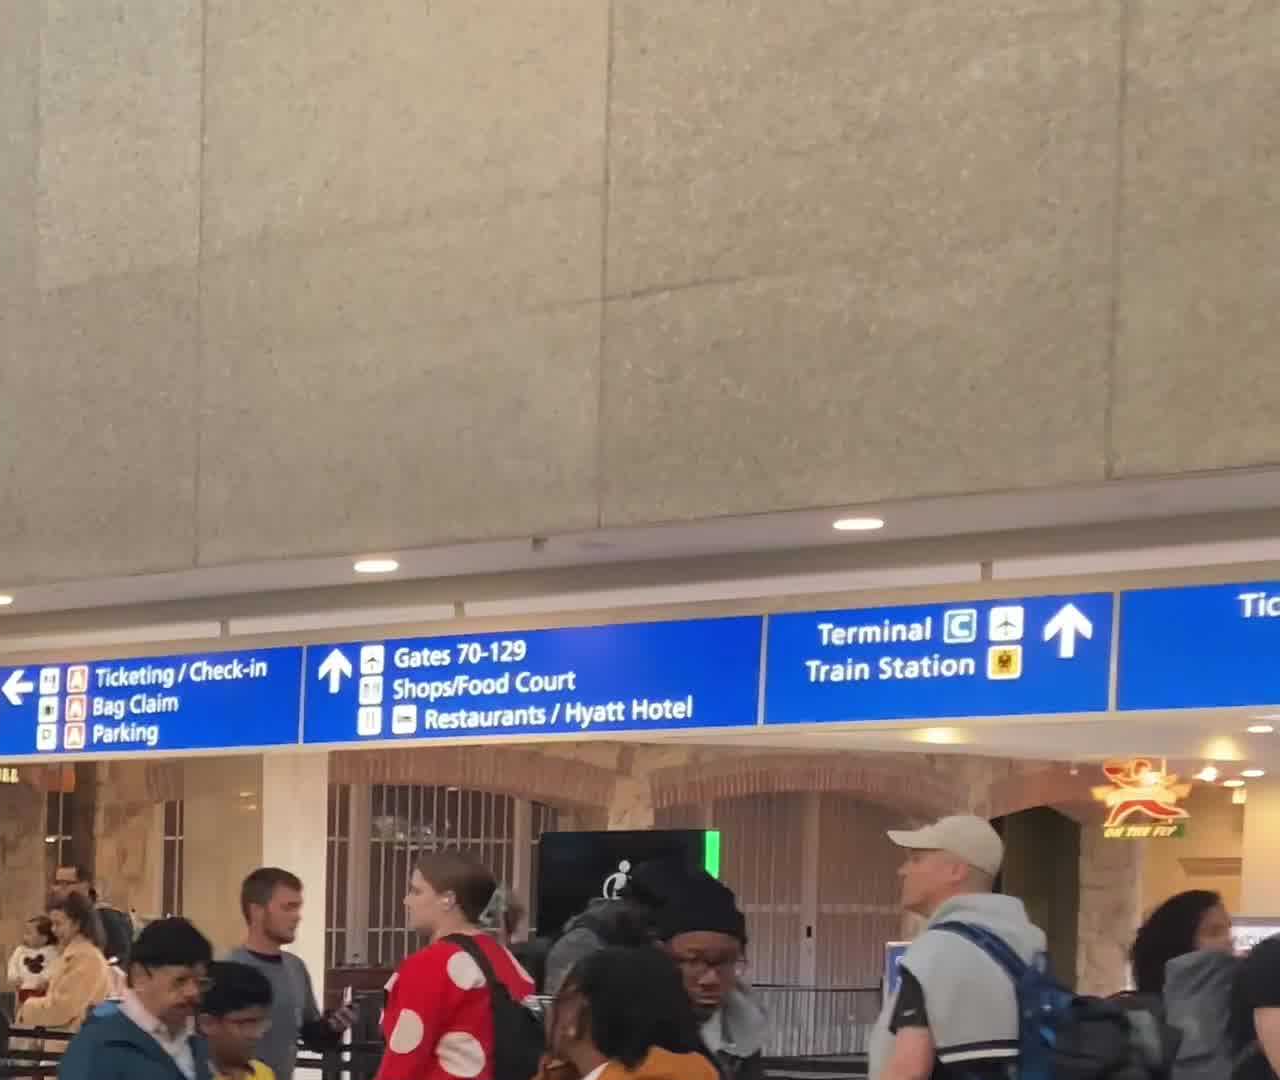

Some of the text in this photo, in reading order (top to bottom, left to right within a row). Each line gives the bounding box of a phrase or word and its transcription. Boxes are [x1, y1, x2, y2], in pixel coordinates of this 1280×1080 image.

[818, 617, 932, 647] Terminal
[394, 640, 526, 669] Gates 70-129
[805, 653, 976, 683] Train Station
[95, 666, 174, 690] Ticketing
[177, 664, 186, 684] /
[189, 659, 268, 683] Check-in
[393, 671, 577, 701] Shops/Food Court
[93, 697, 126, 719] Bag
[130, 694, 179, 715] Claim
[424, 695, 693, 730] Restaurants / Hyatt Hotel
[93, 723, 160, 746] Parking
